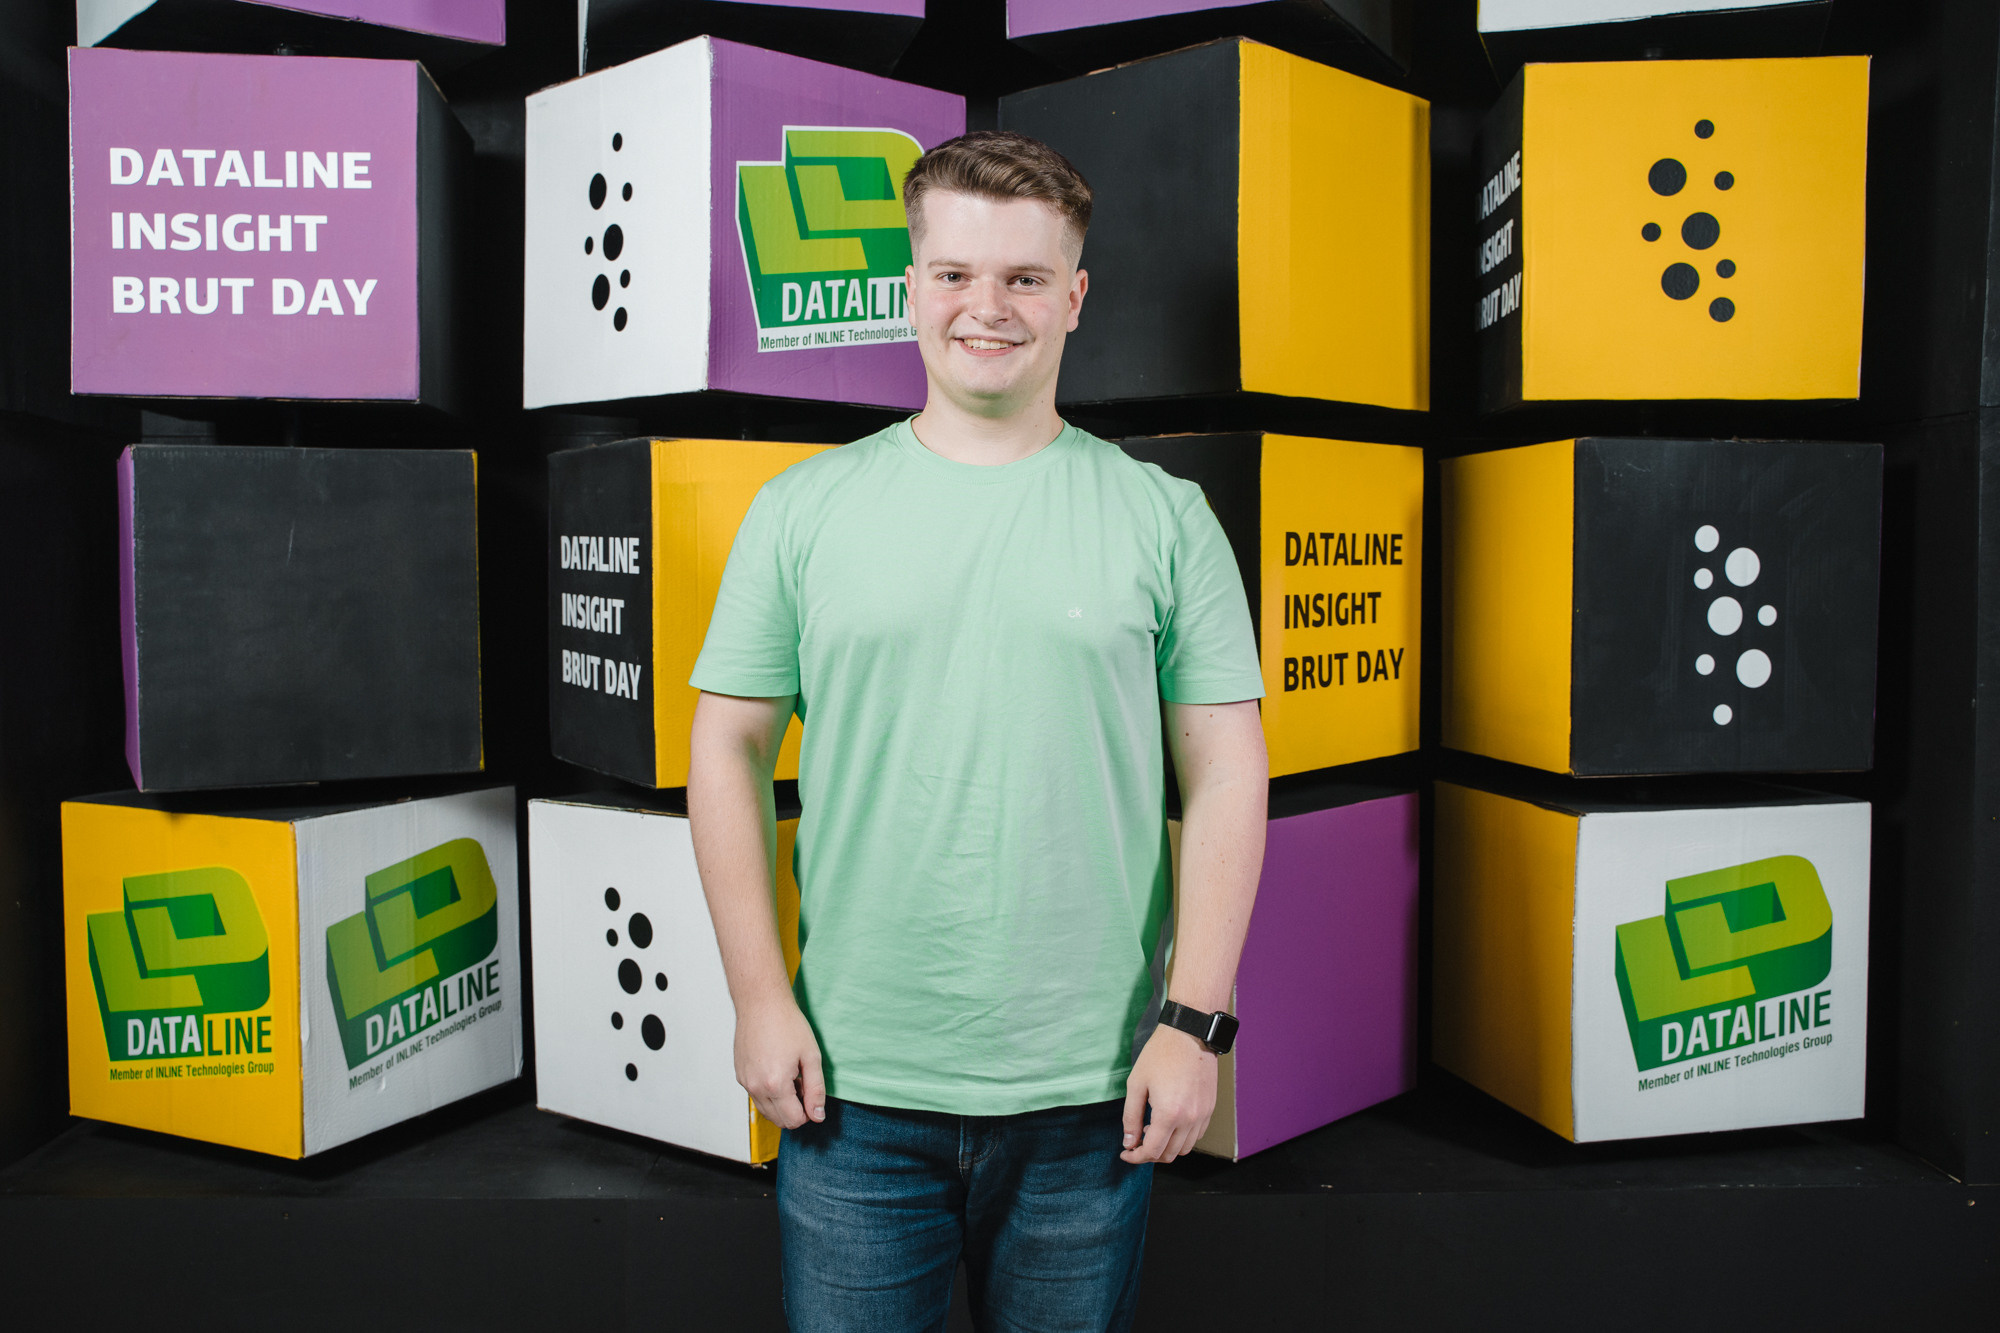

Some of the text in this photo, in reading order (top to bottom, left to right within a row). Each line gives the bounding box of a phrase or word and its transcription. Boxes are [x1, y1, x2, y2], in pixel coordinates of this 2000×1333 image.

[109, 147, 372, 189] DATALINE
[111, 212, 328, 252] INSIGHT
[112, 276, 378, 316] BRUT DAY
[782, 278, 908, 322] DATALIN
[1501, 272, 1522, 318] DAY
[760, 331, 800, 350] Member
[802, 331, 813, 345] of
[815, 330, 845, 344] INLINE
[849, 325, 908, 342] Technologies
[560, 535, 640, 574] DATALINE
[1285, 531, 1403, 566] DATALINE
[561, 593, 625, 635] INSIGHT
[1284, 592, 1382, 629] INSIGHT
[562, 649, 641, 700] BRUT DAY
[1284, 648, 1404, 692] BRUT DAY
[365, 959, 500, 1057] DATALINE
[1661, 989, 1832, 1062] DATALINE
[127, 1014, 272, 1056] DATALINE
[349, 1000, 502, 1091] Member of INLINE Technologies Group
[109, 1061, 275, 1081] Member of INLINE Technologies Group
[1638, 1033, 1833, 1092] Member of INLINE Technologies Group
